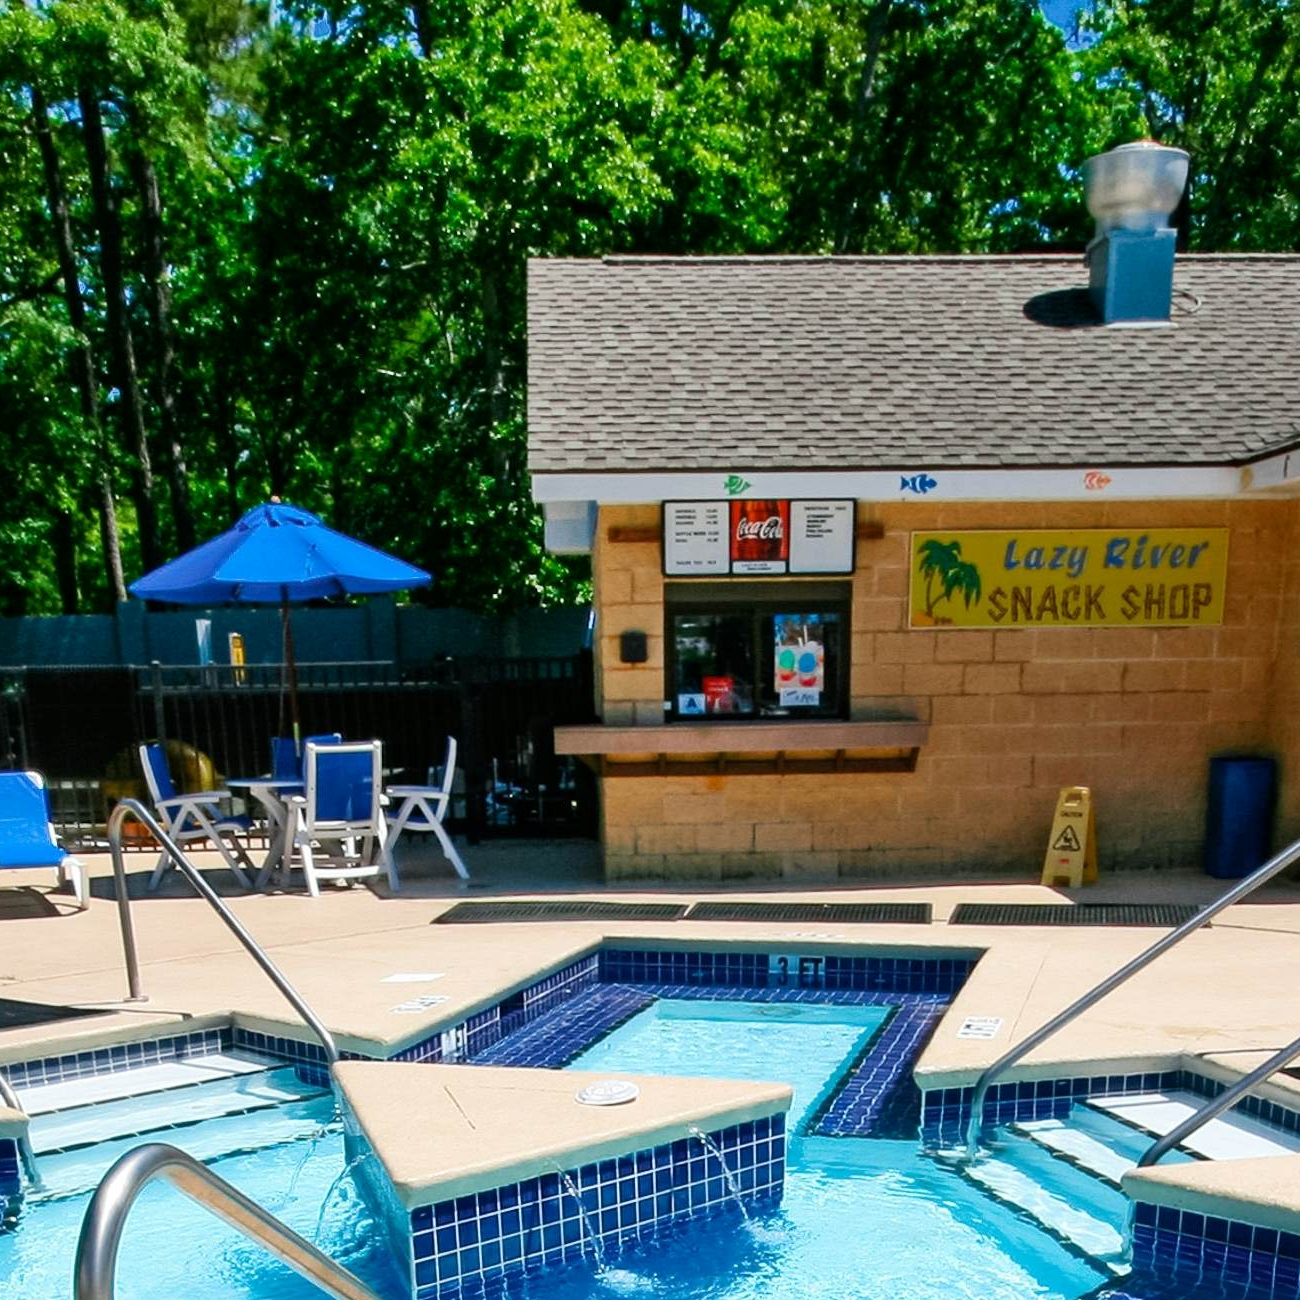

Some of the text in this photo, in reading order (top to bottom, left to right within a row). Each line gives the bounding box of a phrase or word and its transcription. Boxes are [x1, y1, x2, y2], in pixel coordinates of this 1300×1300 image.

[1003, 535, 1210, 578] Lazy River
[987, 583, 1213, 622] SNACK SHOP
[686, 697, 698, 709] A
